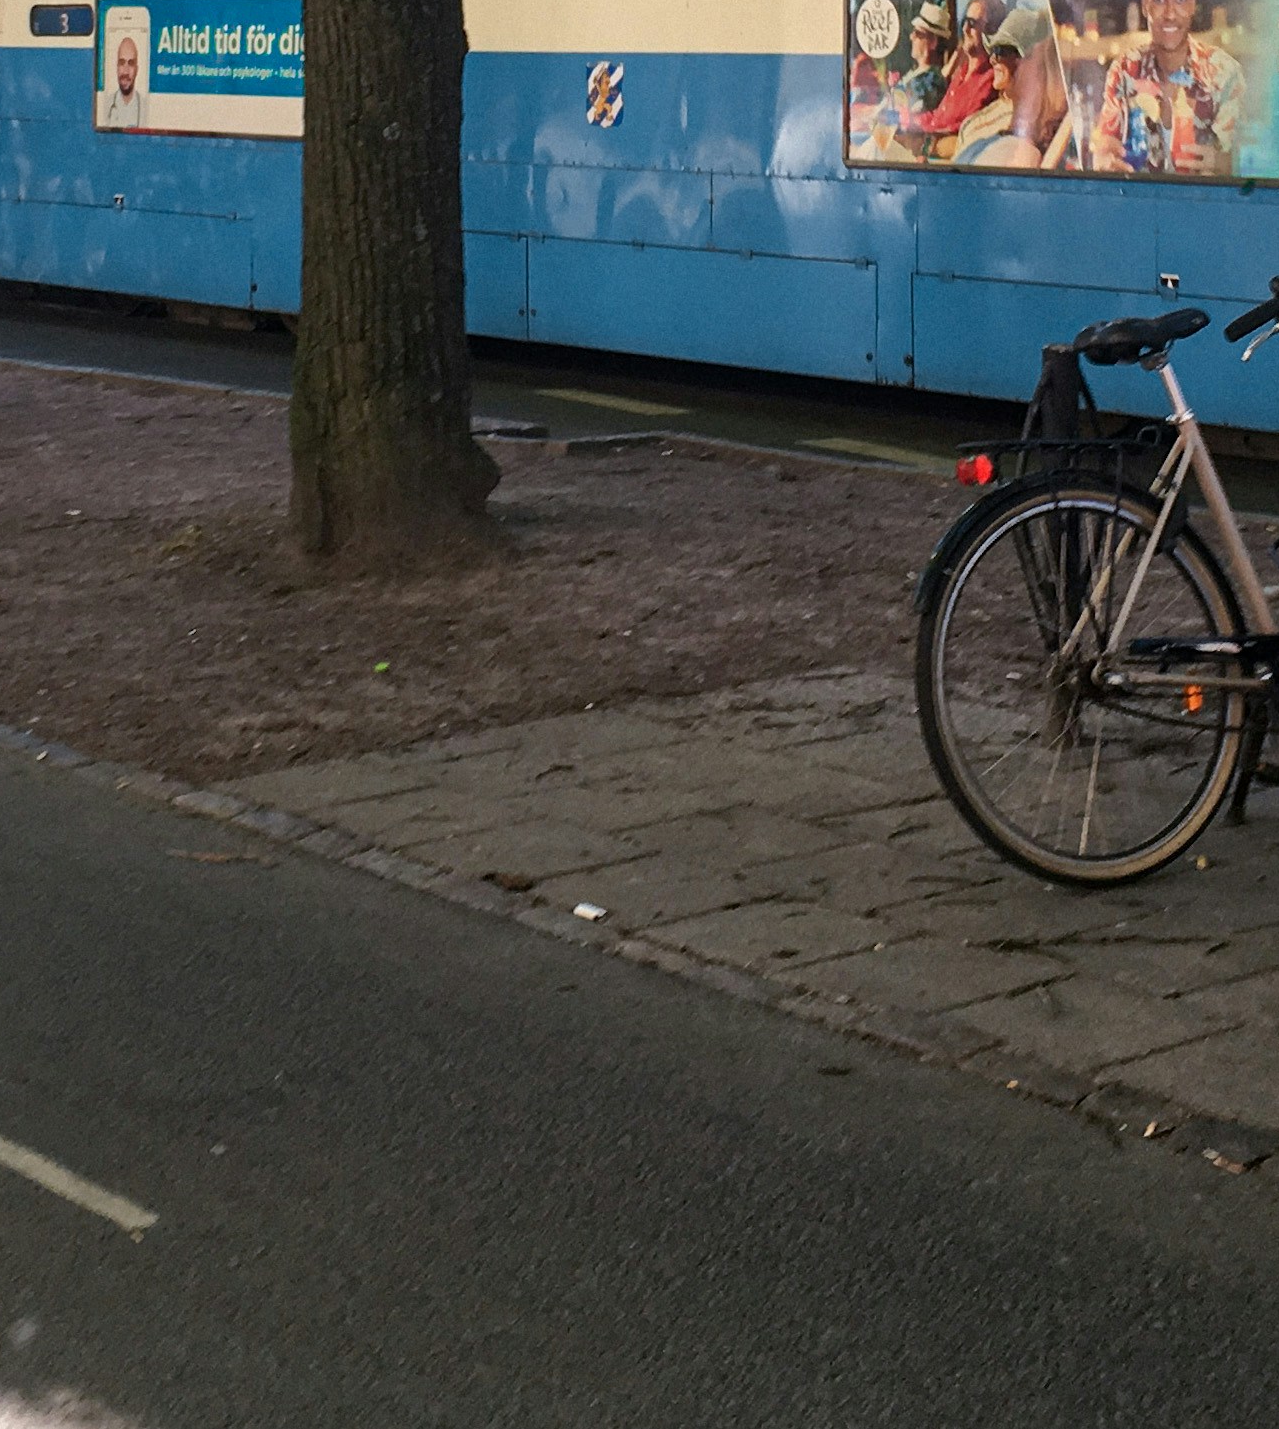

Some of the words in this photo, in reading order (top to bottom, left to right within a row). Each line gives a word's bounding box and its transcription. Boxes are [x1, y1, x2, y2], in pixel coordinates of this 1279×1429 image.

[59, 12, 70, 35] 3
[156, 23, 211, 55] Alltid
[214, 23, 243, 55] tid
[246, 23, 276, 56] för
